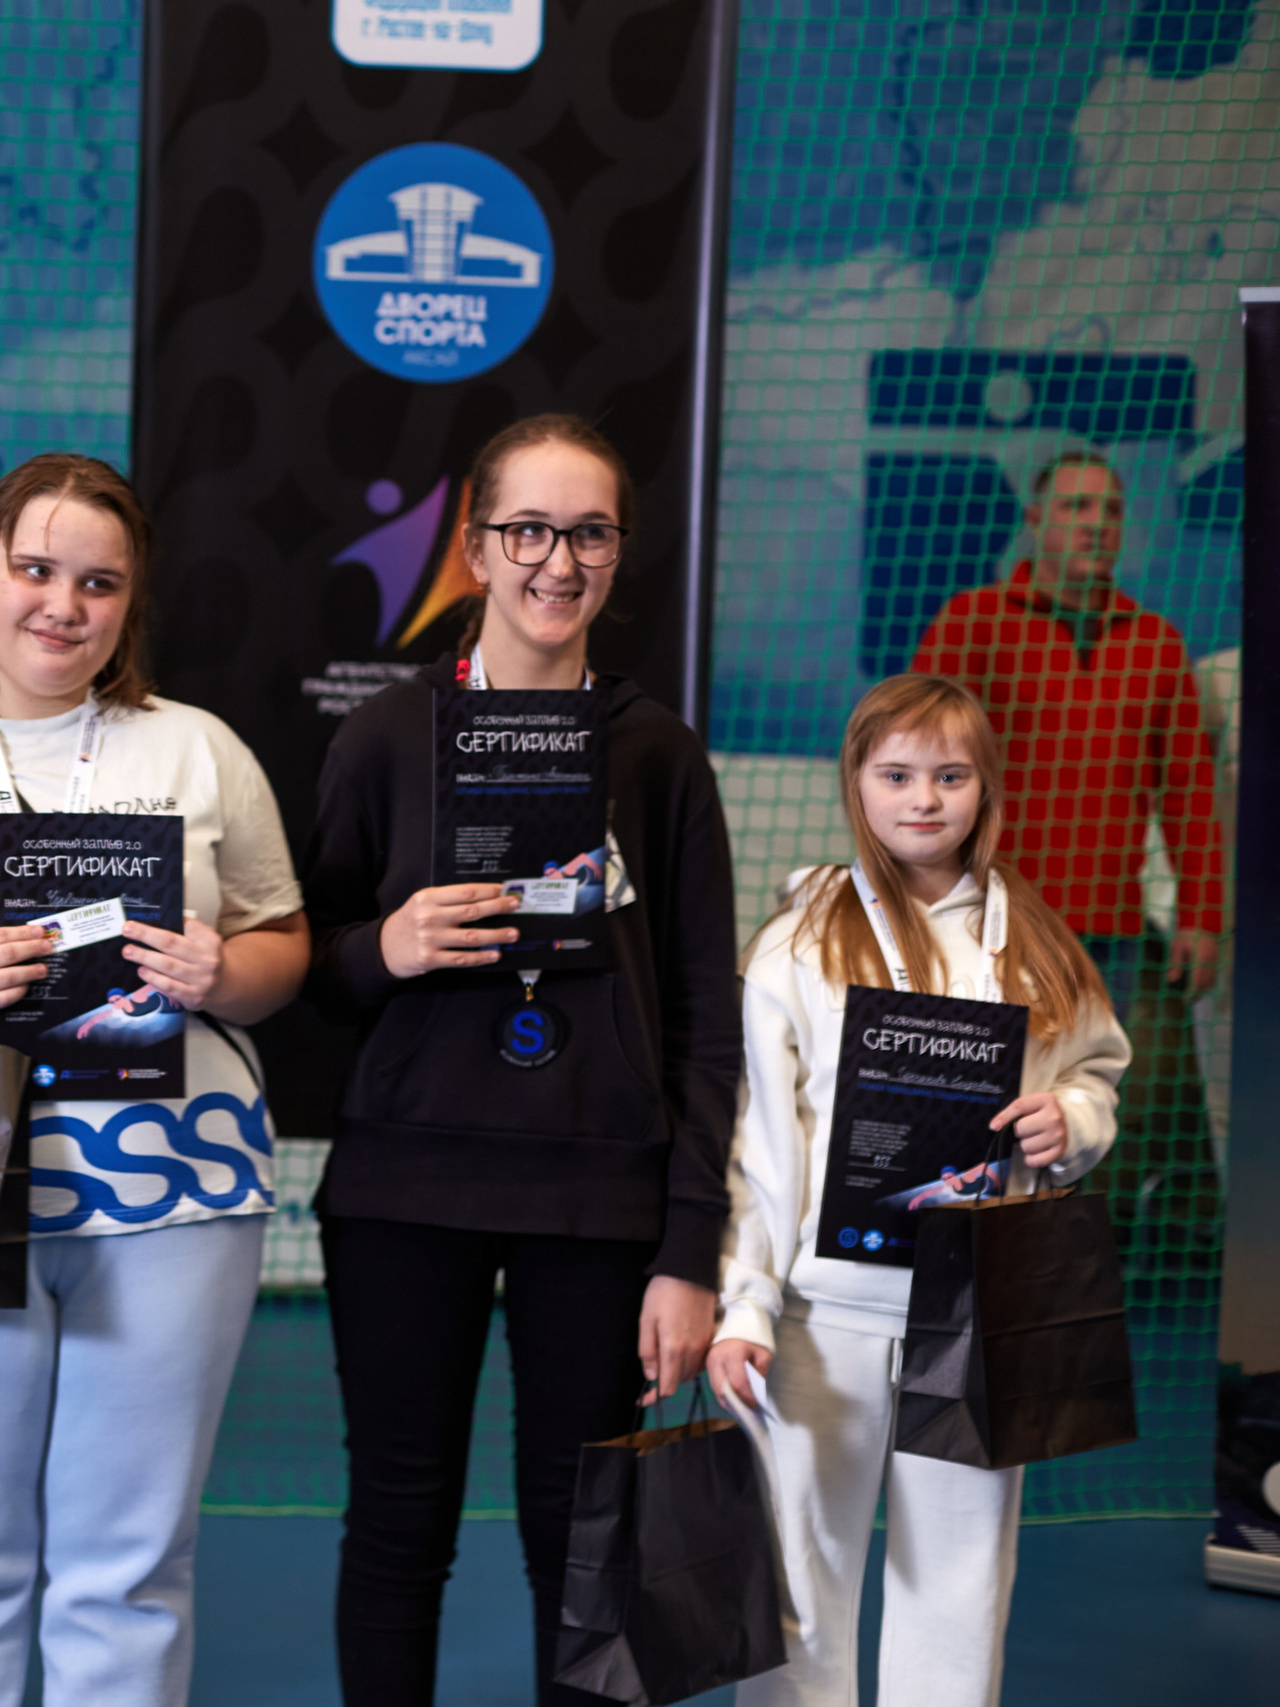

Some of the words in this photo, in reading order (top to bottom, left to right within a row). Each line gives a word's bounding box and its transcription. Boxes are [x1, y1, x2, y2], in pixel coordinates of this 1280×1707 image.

[375, 292, 487, 323] ДВОРЕЦ
[374, 318, 487, 348] СПОРТА
[456, 730, 592, 753] СЕРТИФИКАТ
[125, 841, 142, 850] 2.0
[4, 855, 162, 878] СЕРТИФИКАТ
[511, 1011, 545, 1055] S
[862, 1027, 1008, 1064] СЕРТИФИКАТ
